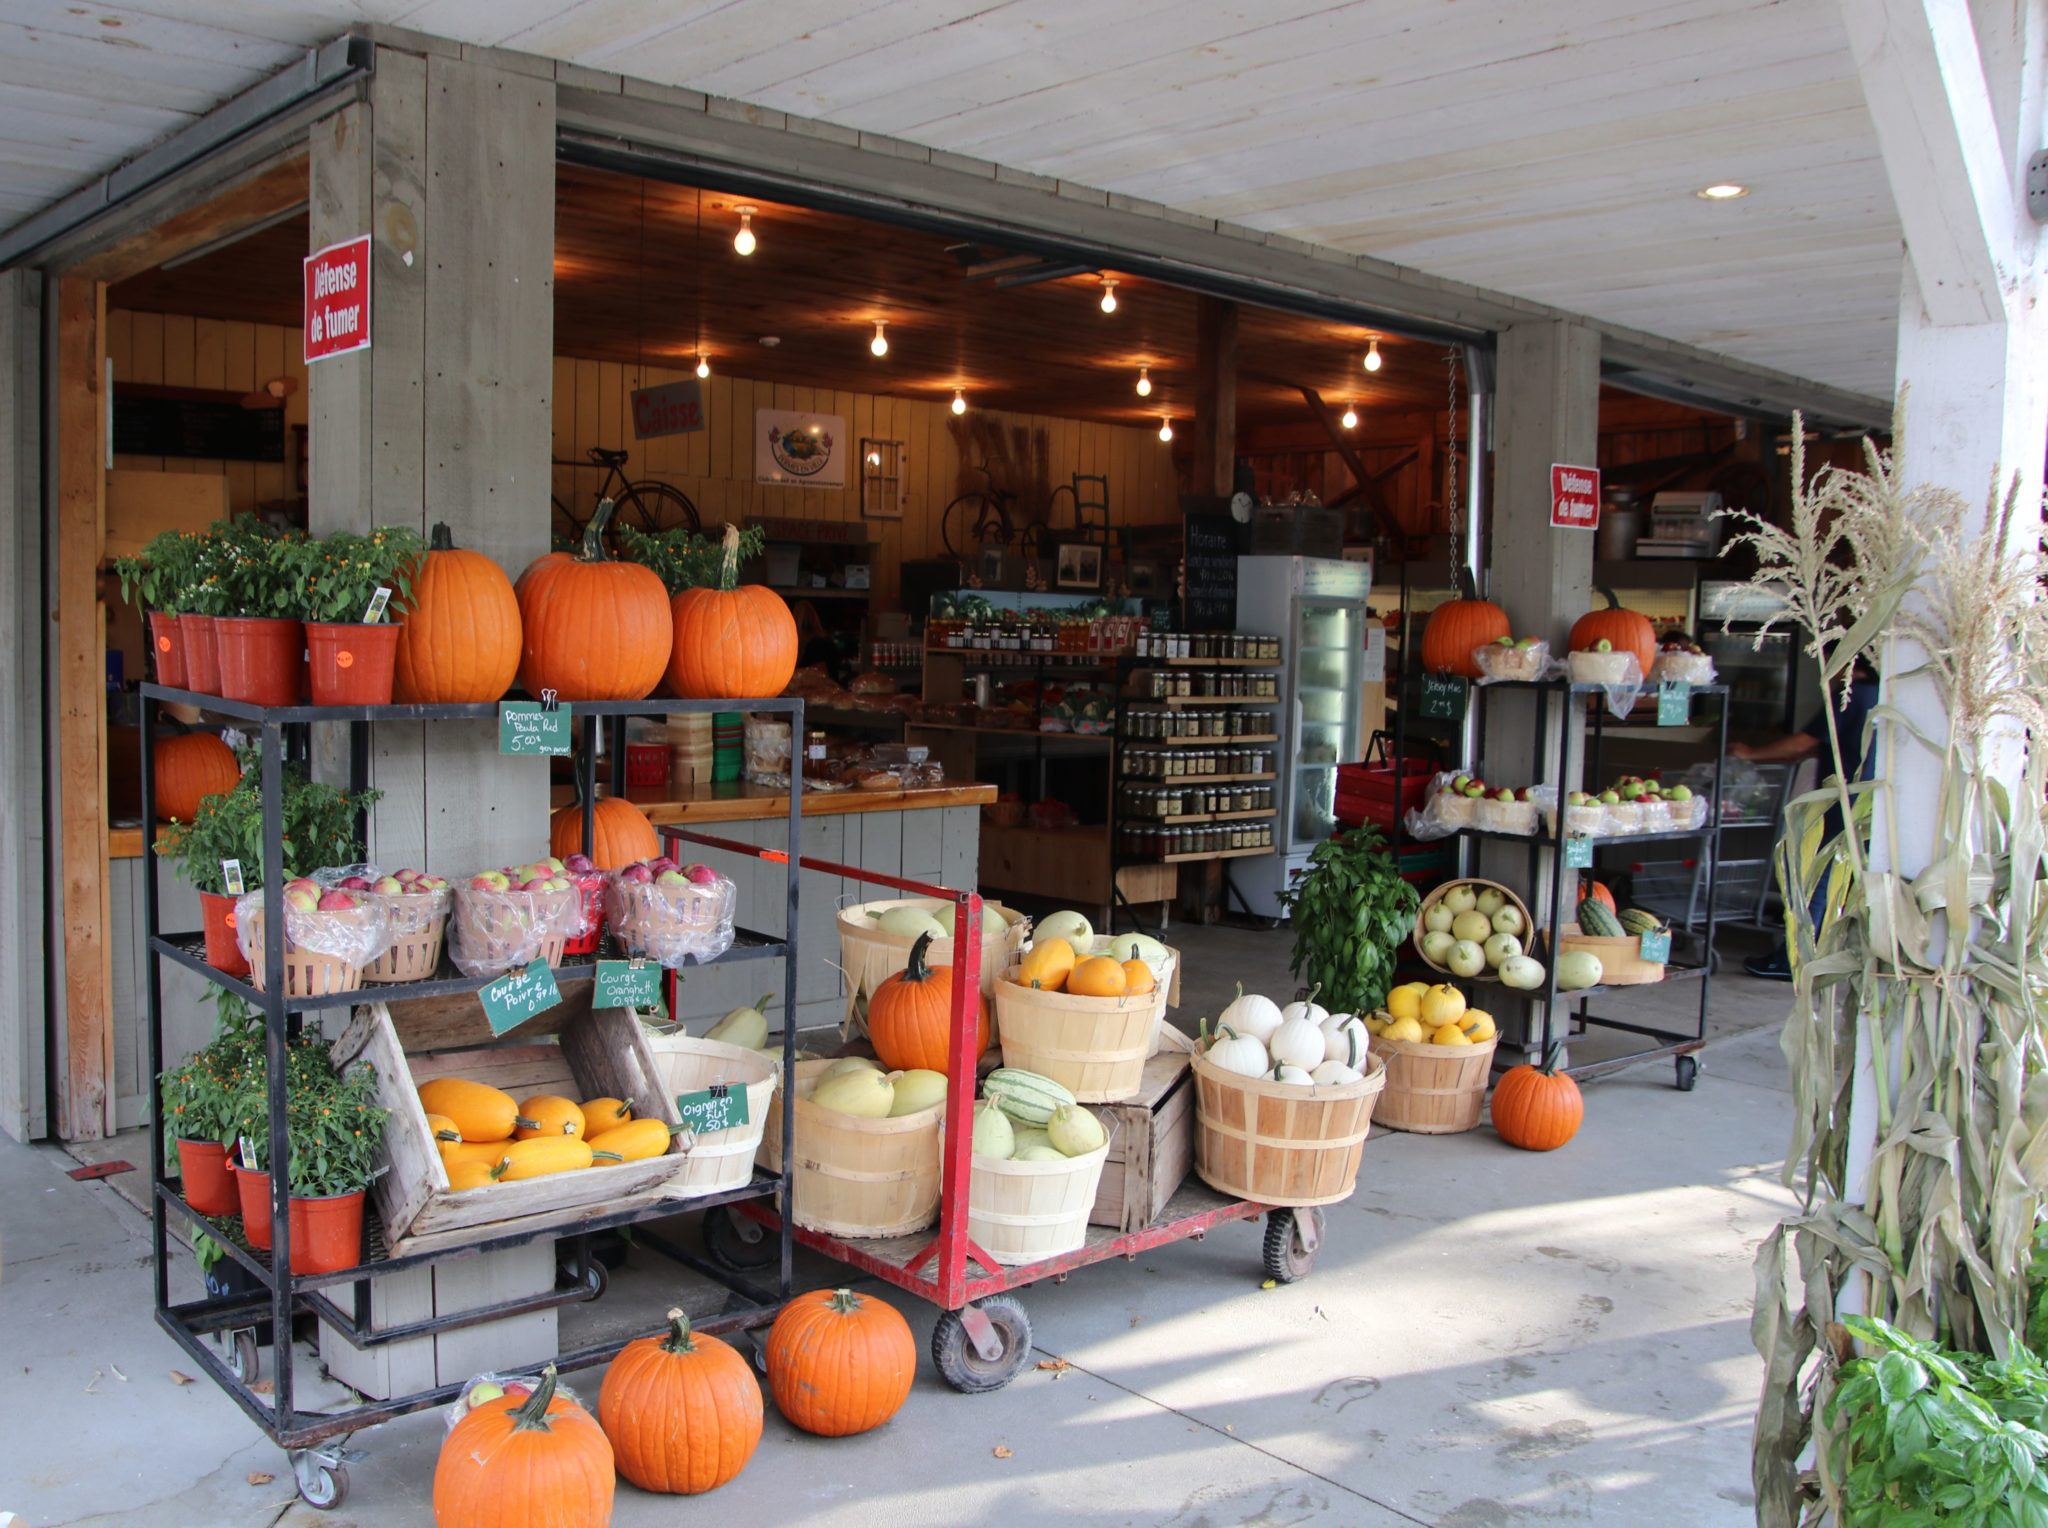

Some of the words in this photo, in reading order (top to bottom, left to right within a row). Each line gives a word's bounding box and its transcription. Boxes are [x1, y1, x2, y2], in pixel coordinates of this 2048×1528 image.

[314, 261, 357, 300] Défense
[311, 311, 323, 343] de
[325, 303, 360, 339] fumer
[634, 393, 701, 433] Caisse
[1561, 472, 1592, 495] Défense
[1558, 498, 1568, 517] de
[1570, 498, 1594, 519] fumer
[1191, 524, 1227, 549] Horaire
[513, 721, 540, 733] Paula
[543, 719, 558, 732] Red
[490, 973, 531, 1003] Courge
[600, 971, 637, 986] Courge
[503, 975, 543, 1011] Poivré
[720, 1097, 732, 1106] en
